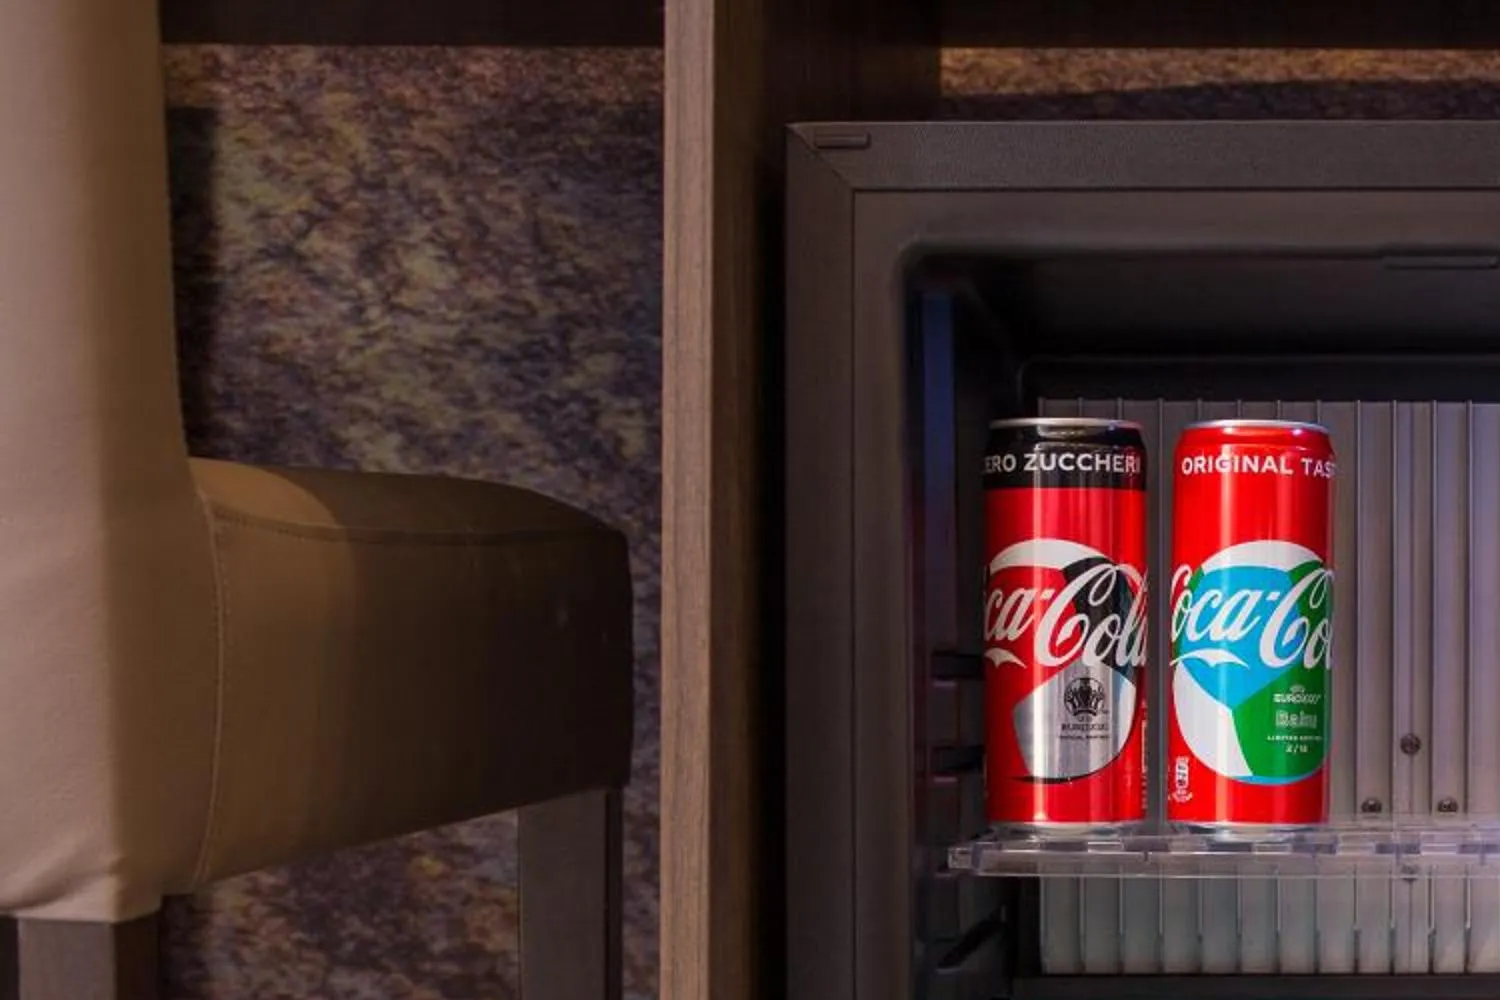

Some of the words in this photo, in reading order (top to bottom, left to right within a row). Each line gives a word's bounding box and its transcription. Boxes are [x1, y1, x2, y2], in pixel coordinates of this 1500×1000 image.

[984, 454, 1017, 473] ERO
[1024, 452, 1141, 474] ZUCCHERI
[1181, 454, 1294, 475] ORIGINAL
[1301, 457, 1337, 479] TAS
[984, 563, 1149, 668] ca-Cola
[1169, 563, 1334, 669] Coca-Co
